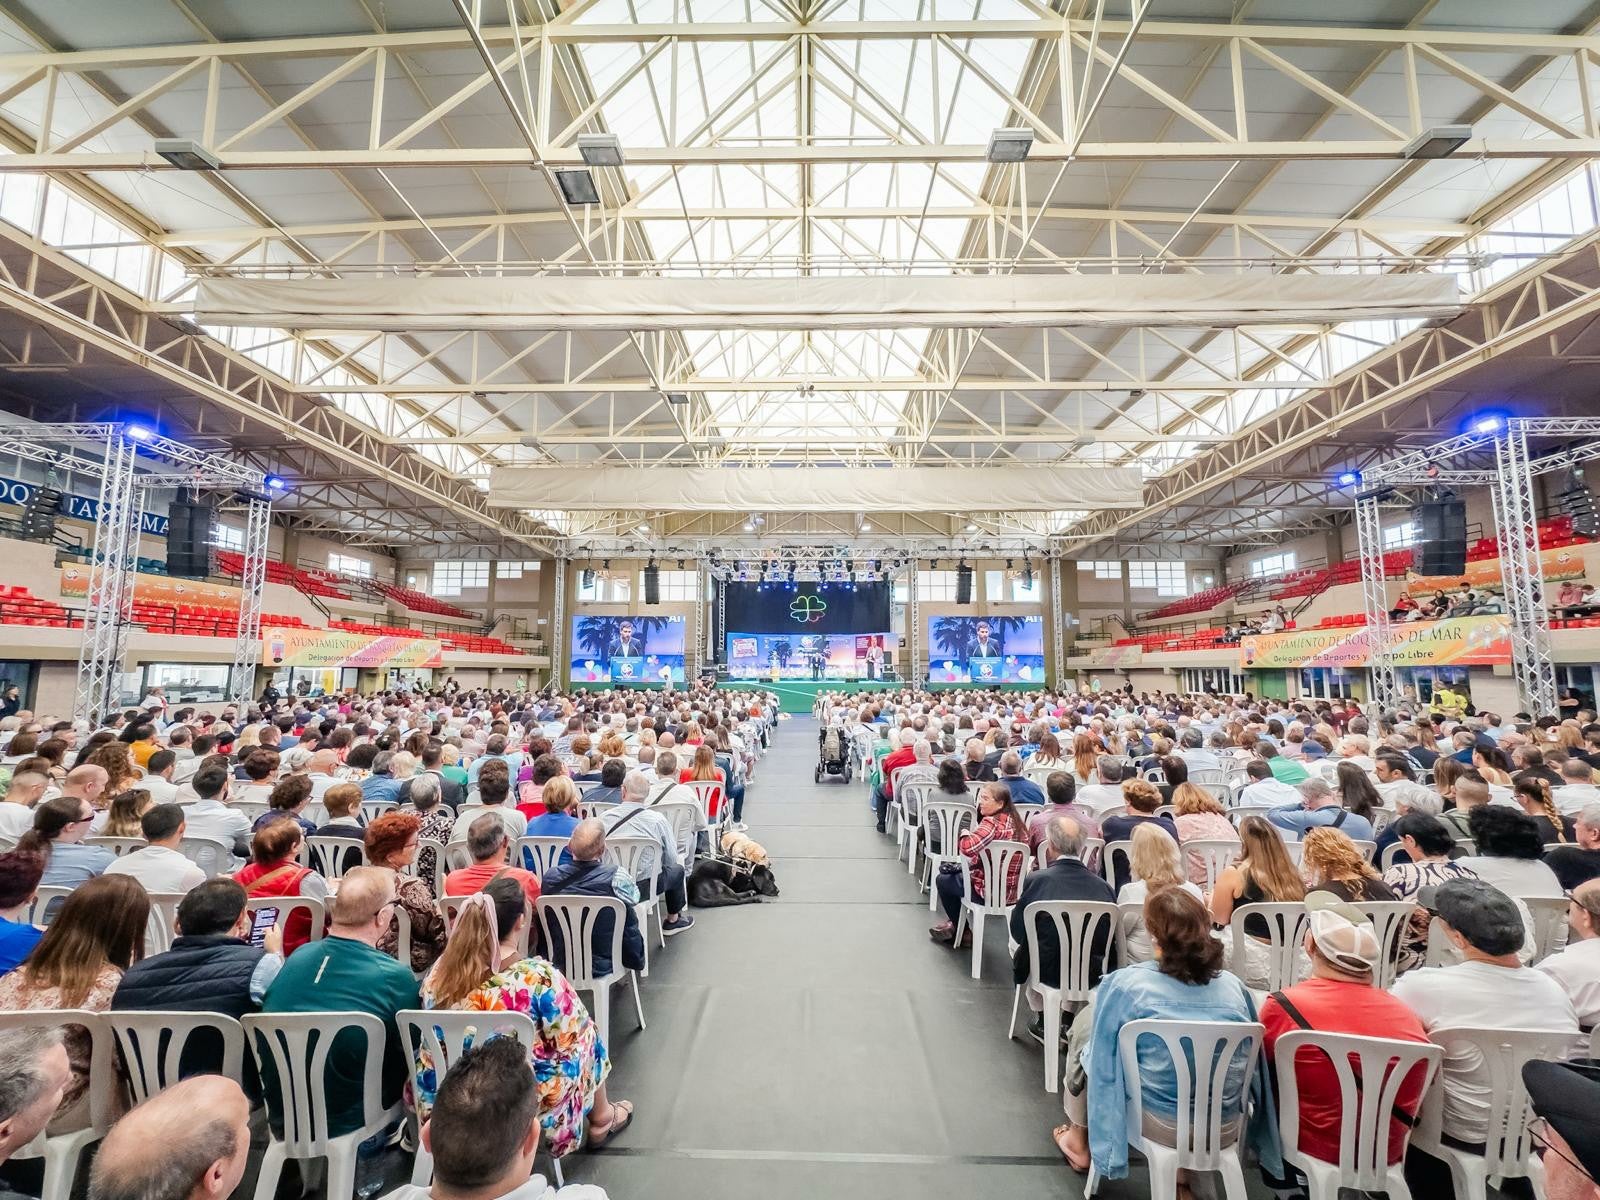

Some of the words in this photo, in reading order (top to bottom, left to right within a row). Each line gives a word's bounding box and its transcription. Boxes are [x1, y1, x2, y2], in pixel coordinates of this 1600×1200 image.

[291, 636, 356, 650] AYUNTAMIENTO
[1259, 637, 1325, 651] AYUNTAMIENTO
[1328, 636, 1343, 647] DE
[1345, 631, 1404, 647] ROQTAS
[1408, 630, 1425, 643] DE
[1429, 626, 1462, 642] MAR
[1408, 649, 1434, 660] Libre
